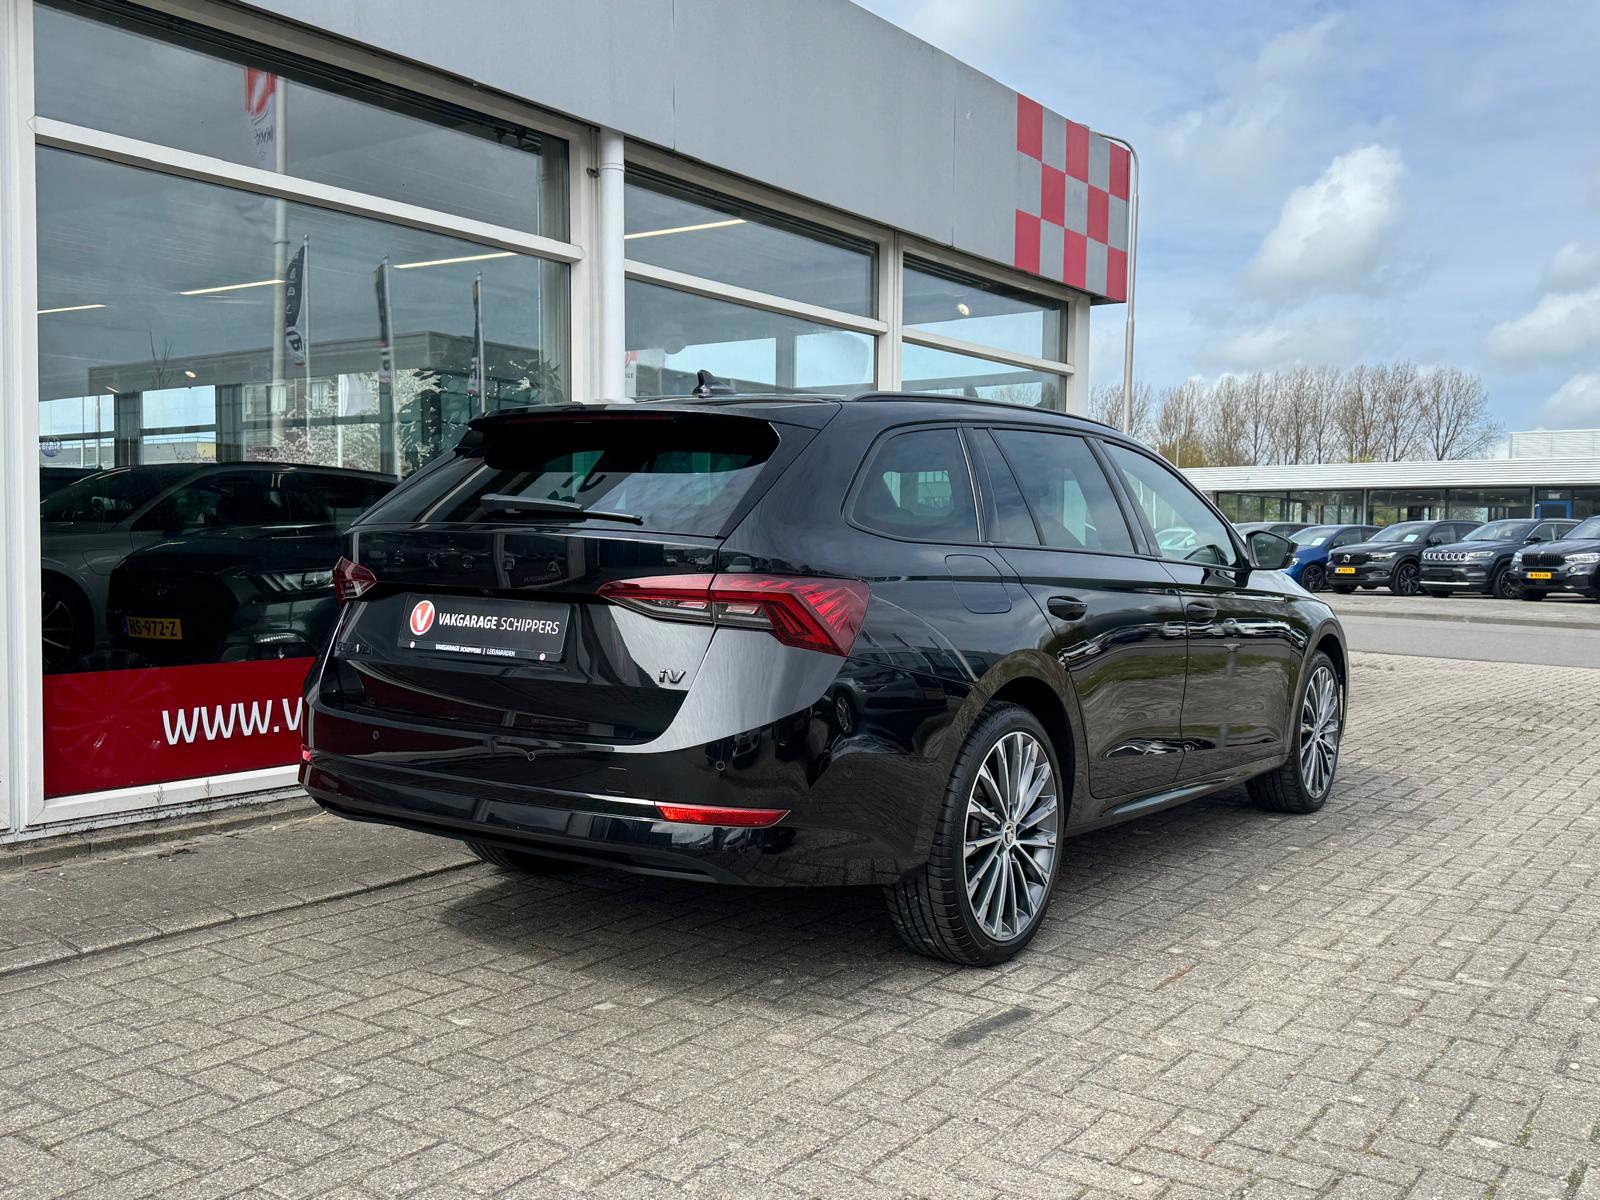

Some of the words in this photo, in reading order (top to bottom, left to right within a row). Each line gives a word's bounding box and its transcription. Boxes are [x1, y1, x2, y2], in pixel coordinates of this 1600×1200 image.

[128, 617, 178, 637] HS-972-Z
[438, 612, 498, 631] VAKGARAGE
[499, 616, 560, 635] SCHIPPERS
